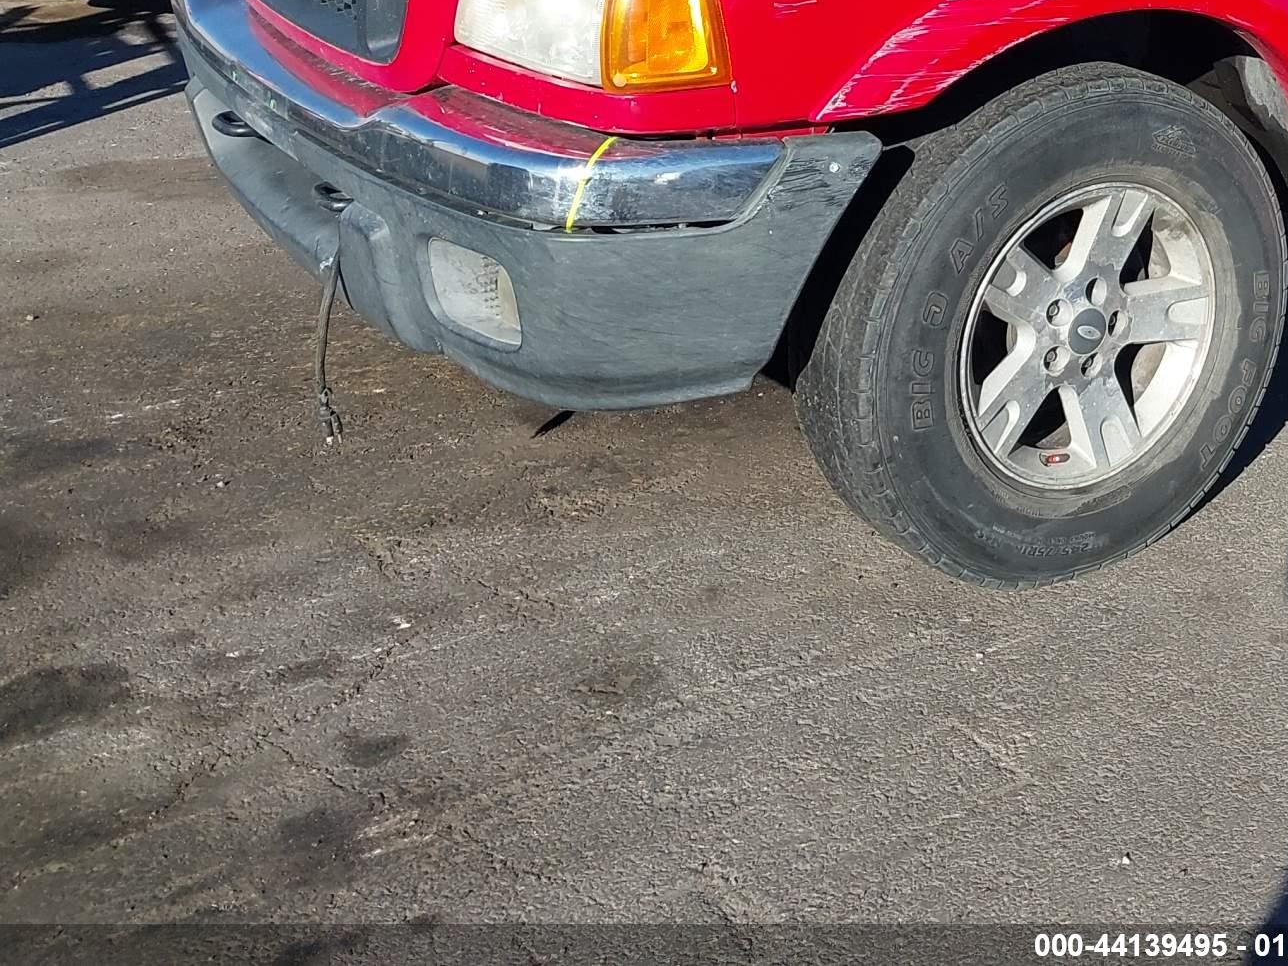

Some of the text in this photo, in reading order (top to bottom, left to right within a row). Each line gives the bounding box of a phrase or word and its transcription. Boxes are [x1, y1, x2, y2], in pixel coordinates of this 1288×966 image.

[911, 349, 936, 430] BIG
[1199, 270, 1270, 472] BIG FOOT
